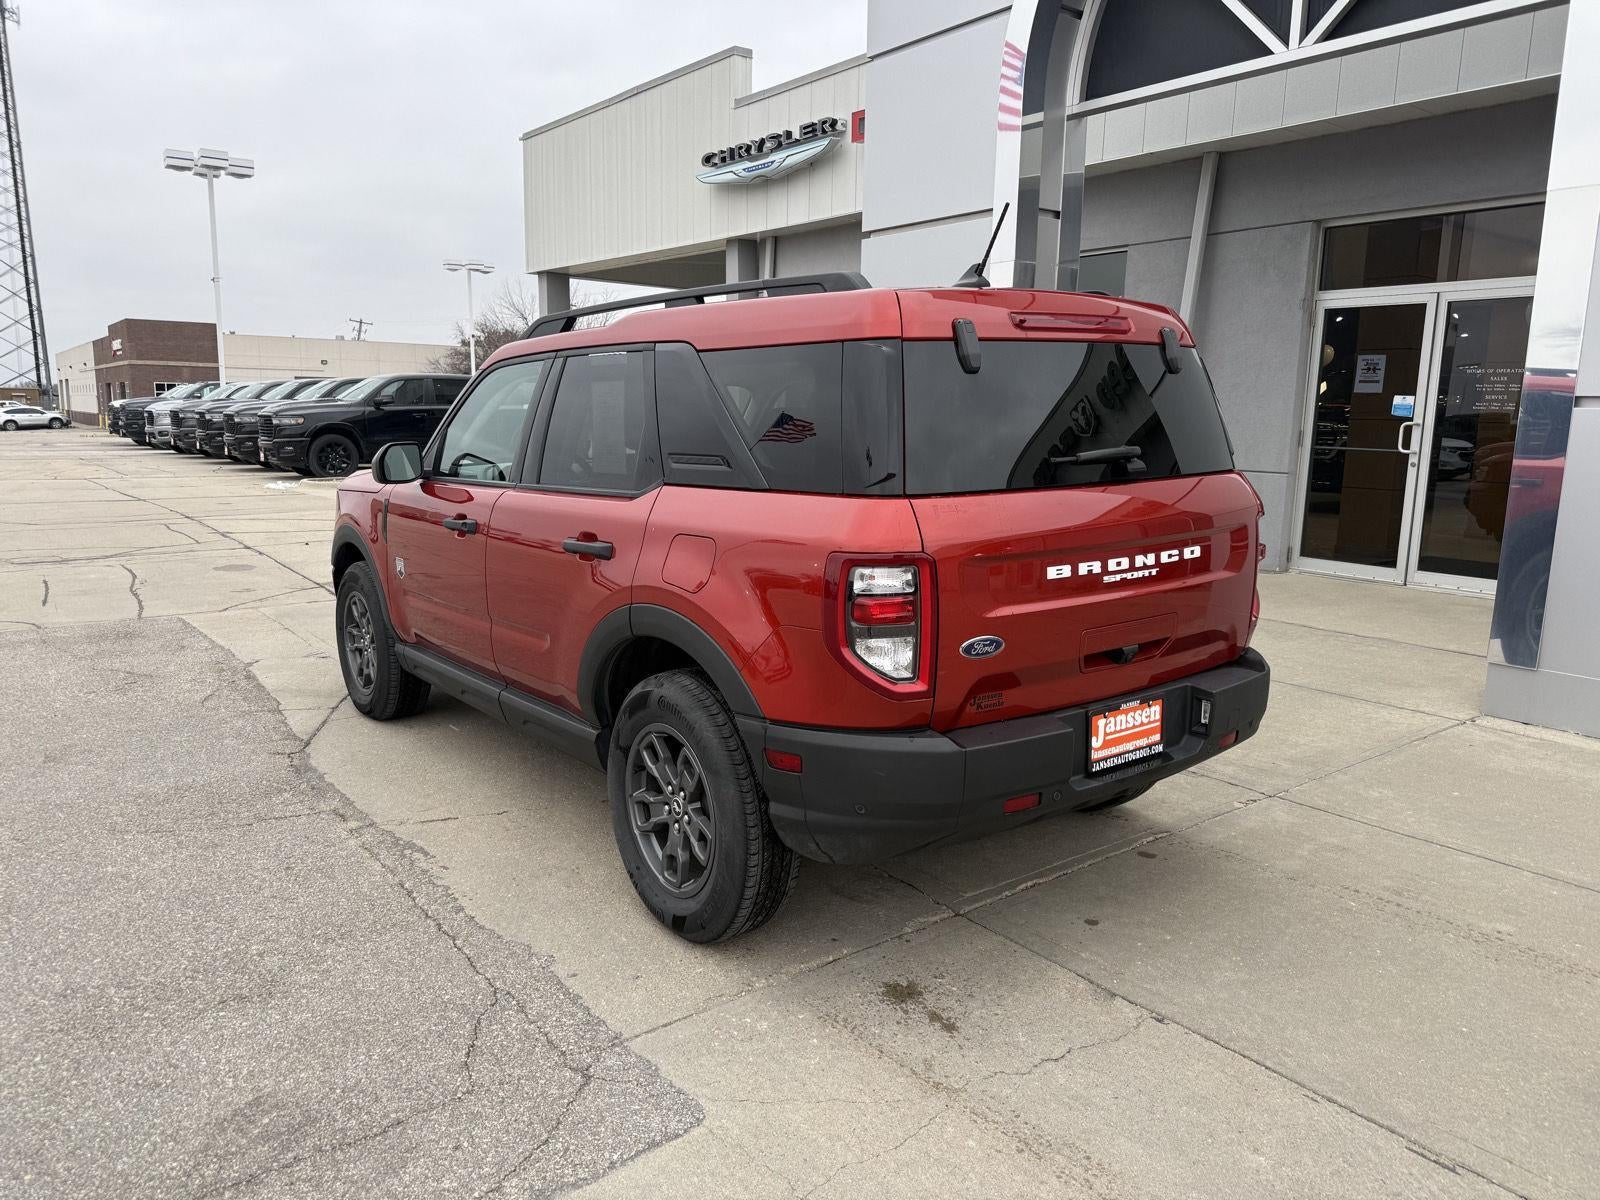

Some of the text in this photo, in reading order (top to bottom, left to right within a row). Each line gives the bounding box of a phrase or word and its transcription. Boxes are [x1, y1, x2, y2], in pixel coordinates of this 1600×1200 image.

[701, 116, 839, 167] CHRYSLER
[1046, 545, 1201, 580] BRONCO
[1102, 568, 1160, 583] SPORT
[971, 641, 996, 655] Ford
[1091, 704, 1161, 749] Janssen
